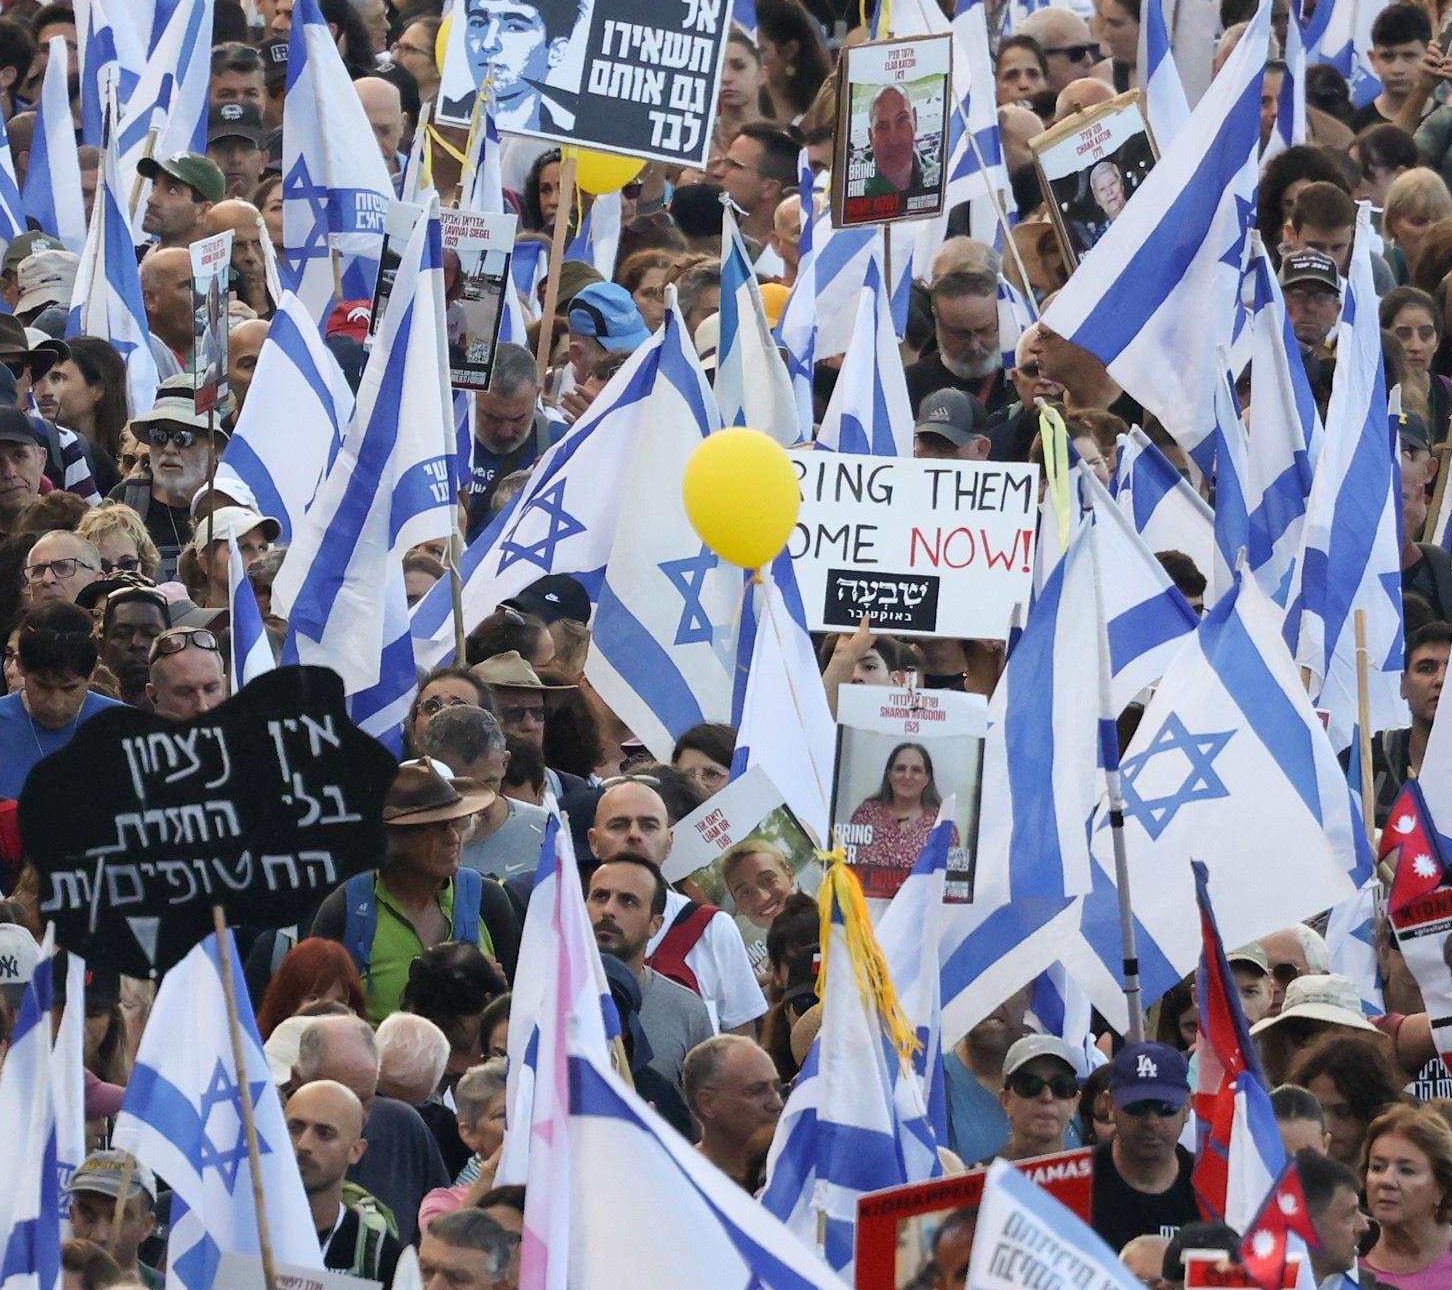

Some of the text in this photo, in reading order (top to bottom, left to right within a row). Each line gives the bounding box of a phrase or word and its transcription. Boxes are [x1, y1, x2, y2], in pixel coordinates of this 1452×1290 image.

[603, 20, 713, 72] תשאירו
[885, 60, 897, 70] ELAD
[588, 58, 708, 113] גם אותם
[649, 110, 699, 153] לבד
[848, 160, 875, 179] BRING
[847, 177, 865, 197] HIM
[442, 225, 490, 239] (AVIVA) SIEGEL
[444, 236, 458, 246] (62)
[922, 468, 1031, 511] THEM
[907, 524, 1030, 571] NOW!
[879, 708, 909, 719] SHARON
[903, 719, 919, 733] (52)
[122, 713, 340, 798] אין ניצחון
[85, 771, 356, 857] בלי החזרת
[702, 818, 731, 843] LIAM OR
[715, 833, 732, 849] (18)
[0, 955, 19, 977] NY
[1137, 1054, 1157, 1077] LA
